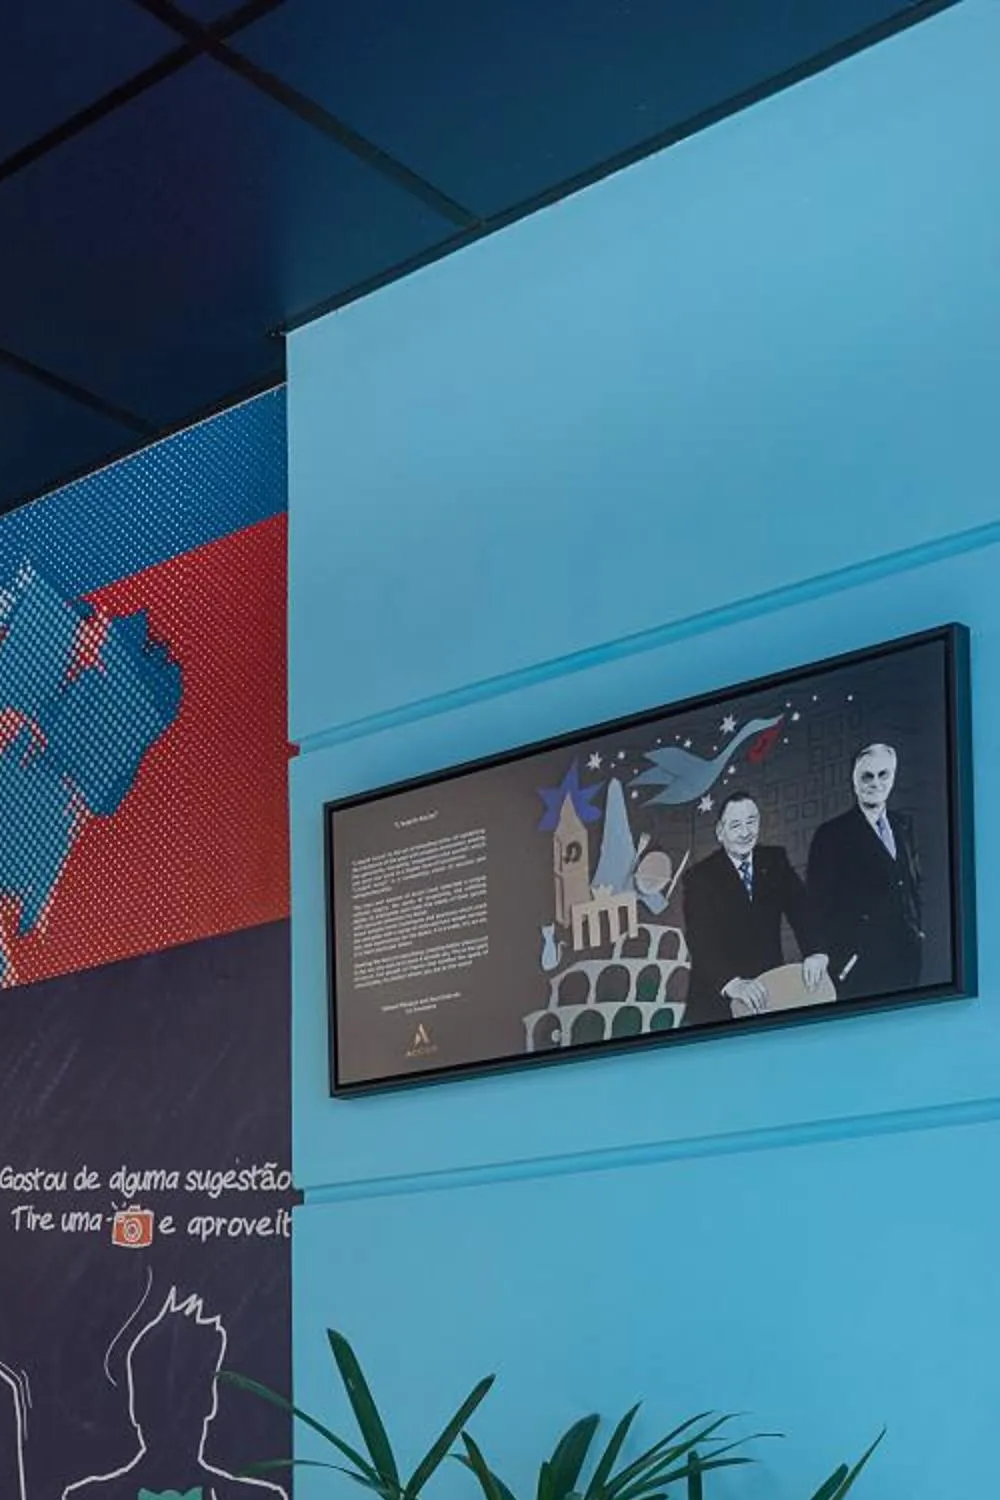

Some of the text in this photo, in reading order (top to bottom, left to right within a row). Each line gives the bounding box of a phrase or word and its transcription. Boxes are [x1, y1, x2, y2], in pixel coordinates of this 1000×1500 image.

[0, 1162, 291, 1198] Gostou de alguma sugestão
[10, 1204, 55, 1231] Tire
[61, 1210, 102, 1231] uma
[158, 1215, 177, 1234] e
